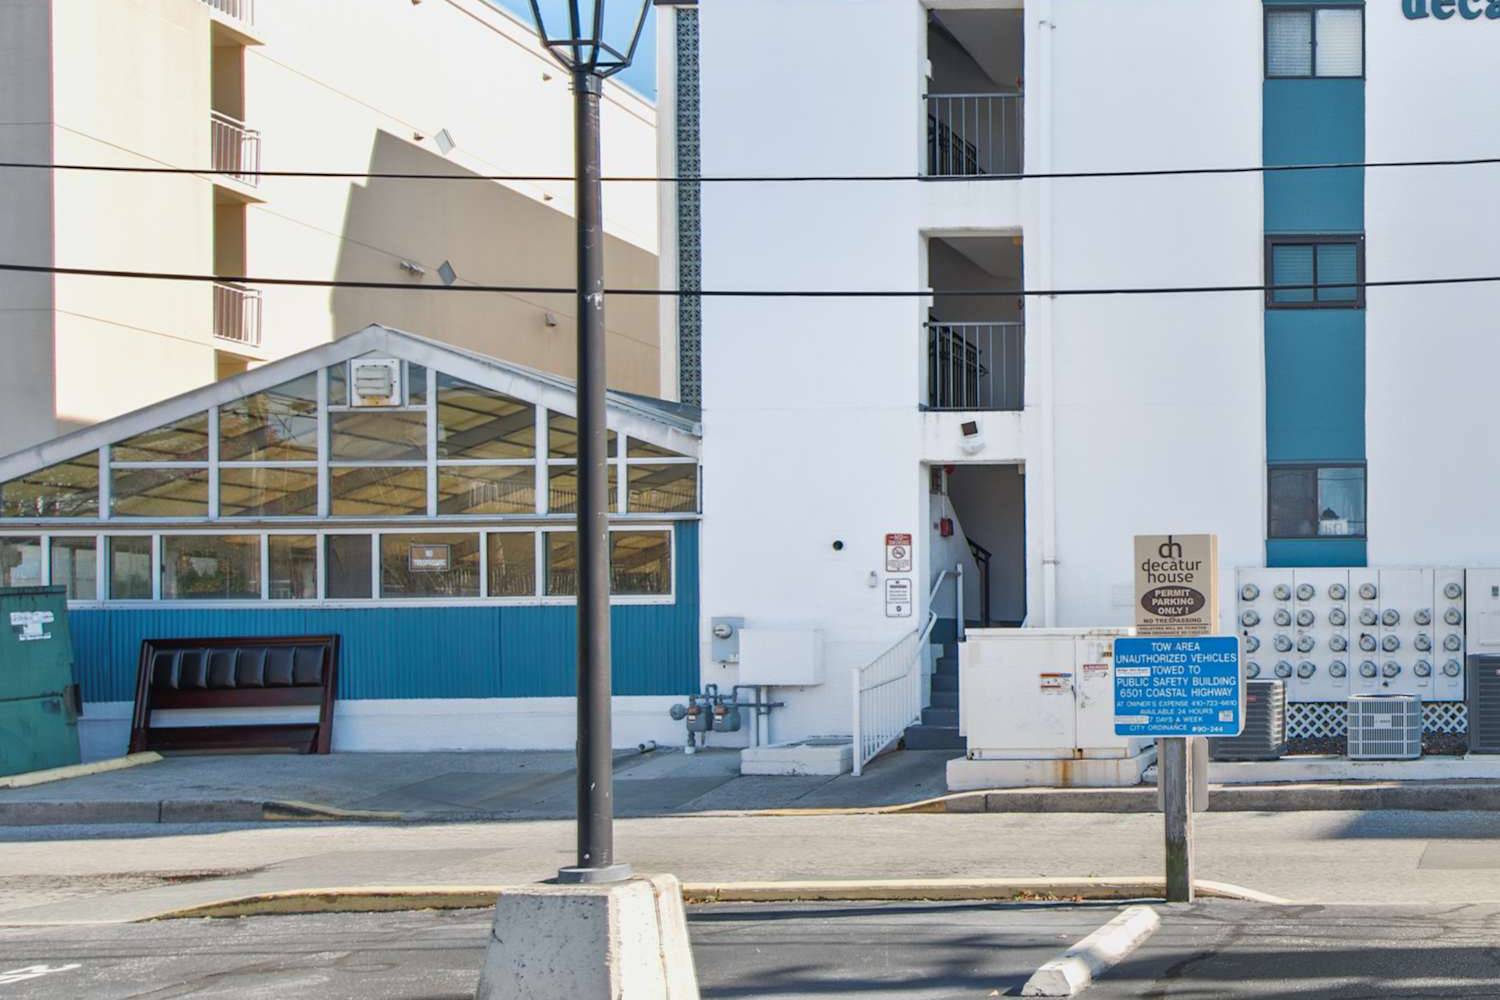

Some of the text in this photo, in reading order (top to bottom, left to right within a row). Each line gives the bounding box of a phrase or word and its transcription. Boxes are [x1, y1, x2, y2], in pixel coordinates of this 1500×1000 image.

[1141, 558, 1202, 572] decatur
[1147, 570, 1195, 584] house
[1154, 589, 1191, 598] PERMIT
[1151, 597, 1195, 606] PARKING
[1157, 606, 1183, 615] ONLY
[1151, 642, 1200, 652] TOW AREA
[1115, 653, 1237, 664] UNAUTHORIZED VEHICLES
[1151, 666, 1185, 676] TOWED
[1188, 665, 1201, 675] TO
[1117, 676, 1236, 687] PUBLIC SAFETY BUILDING
[1120, 687, 1233, 698] 6501 COASTAL HIGHWAY
